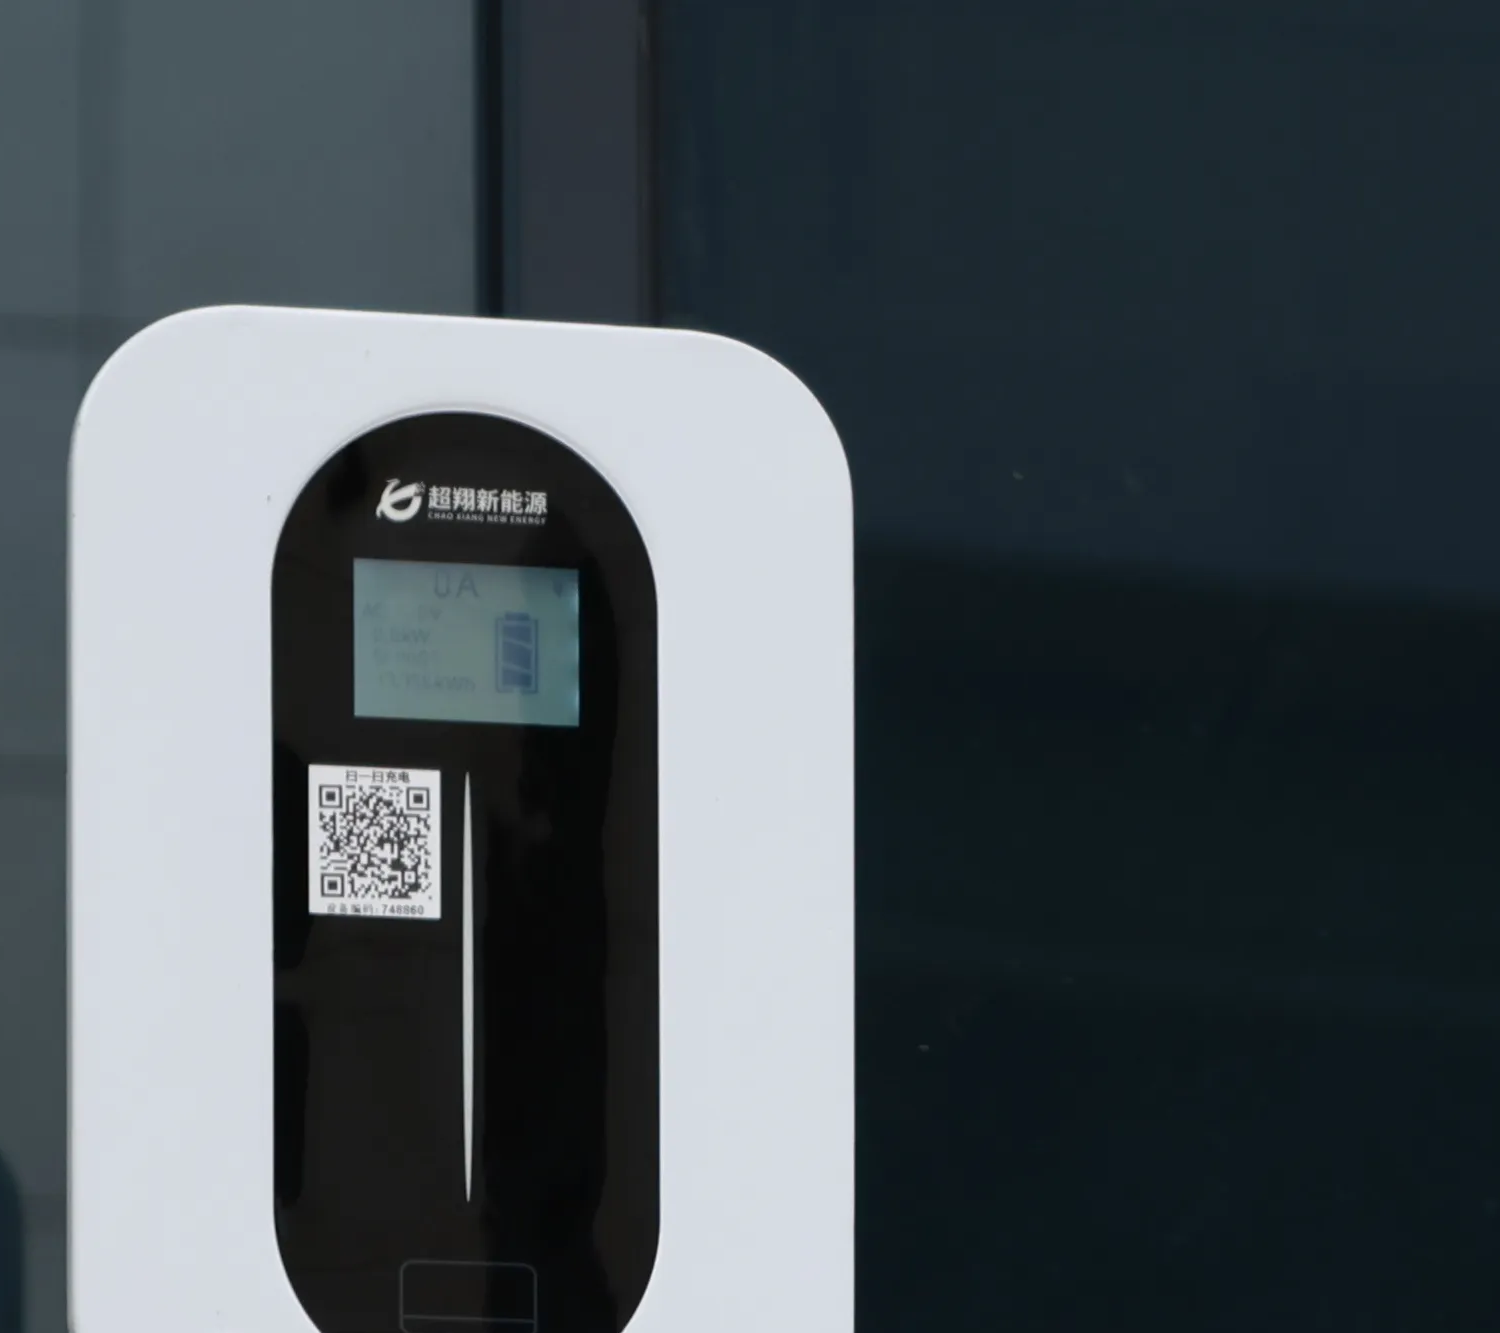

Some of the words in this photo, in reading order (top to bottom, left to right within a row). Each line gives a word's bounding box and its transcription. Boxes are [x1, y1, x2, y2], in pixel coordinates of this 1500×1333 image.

[428, 485, 547, 514] 超翔新能源
[428, 510, 454, 520] CHAO
[487, 514, 508, 523] NEW
[510, 515, 547, 525] ENERGY
[345, 769, 411, 784] 扫一扫充电
